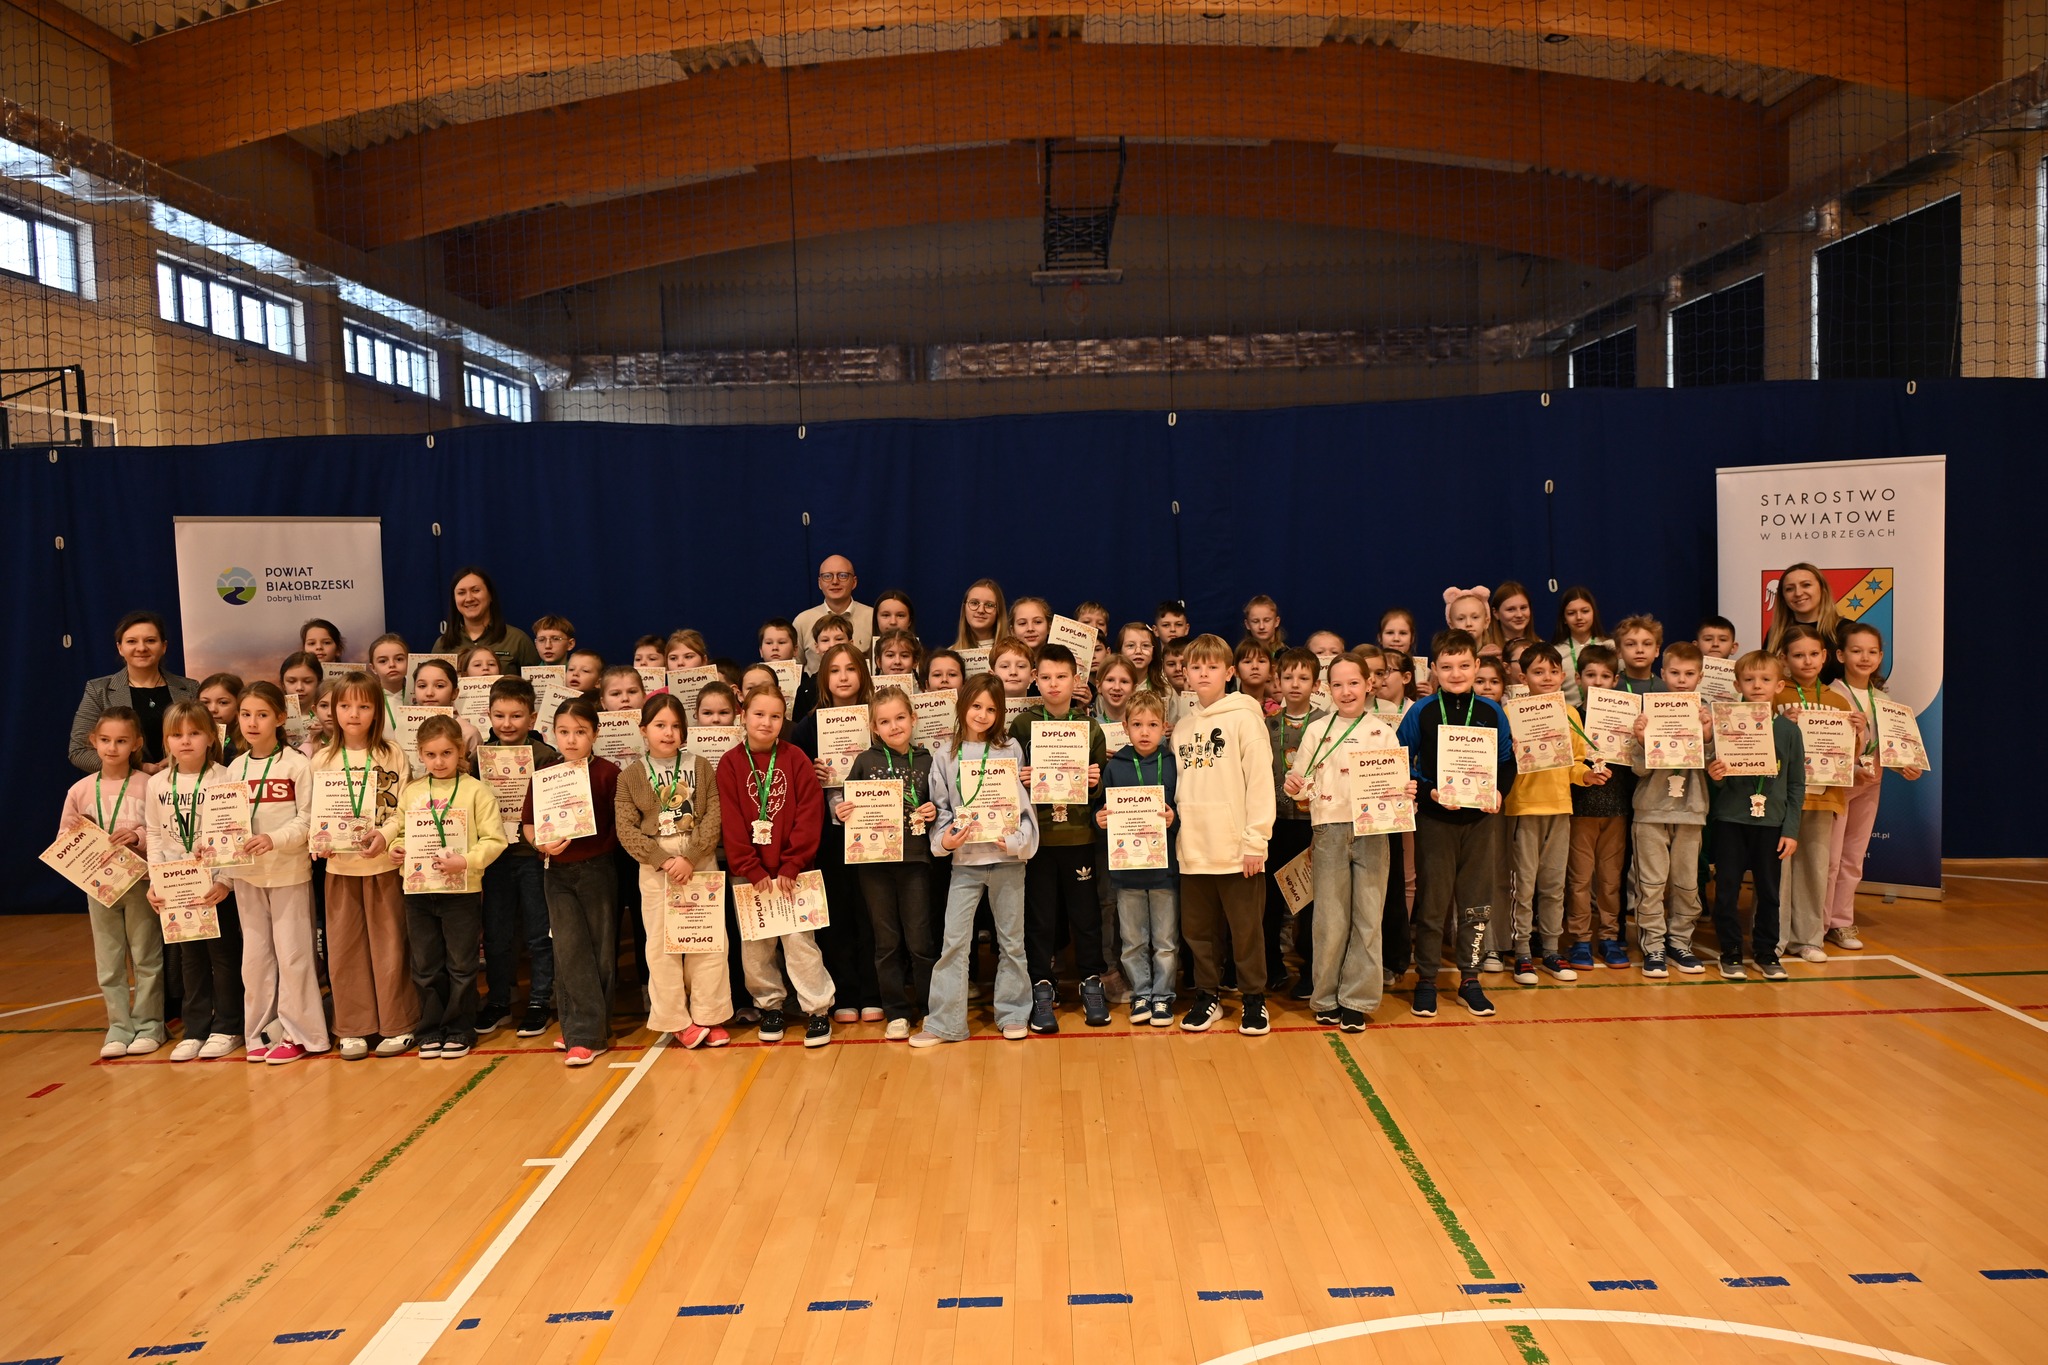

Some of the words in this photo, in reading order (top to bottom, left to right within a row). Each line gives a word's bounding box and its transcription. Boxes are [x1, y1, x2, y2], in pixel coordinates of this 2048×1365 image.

[1760, 488, 1896, 506] STAROSTWO
[1760, 510, 1895, 526] POWIATOWE
[1781, 528, 1895, 540] BIAŁOBRZEGACH
[265, 567, 313, 577] POWIAT
[266, 580, 354, 591] BIAŁOBRZESKI
[267, 595, 292, 603] Dobry
[1060, 626, 1087, 639] DYPLOM
[1704, 664, 1735, 673] DYPLOM
[677, 676, 707, 684] DYPLOM
[915, 700, 946, 709] DYPLOM
[1598, 697, 1630, 706] DYPLOM
[1519, 703, 1553, 714] DYPLOM
[1882, 707, 1906, 717] DYPLOM
[1449, 735, 1484, 743] DYPLOM
[1360, 758, 1395, 767] DYPLOM
[542, 770, 575, 782] DYPLOM
[211, 792, 237, 801] DYPLOM
[56, 832, 86, 860] DYPLOM
[163, 868, 198, 878] DYPLOM
[1285, 875, 1300, 902] DYPLOM
[754, 895, 765, 928] DYPLOM
